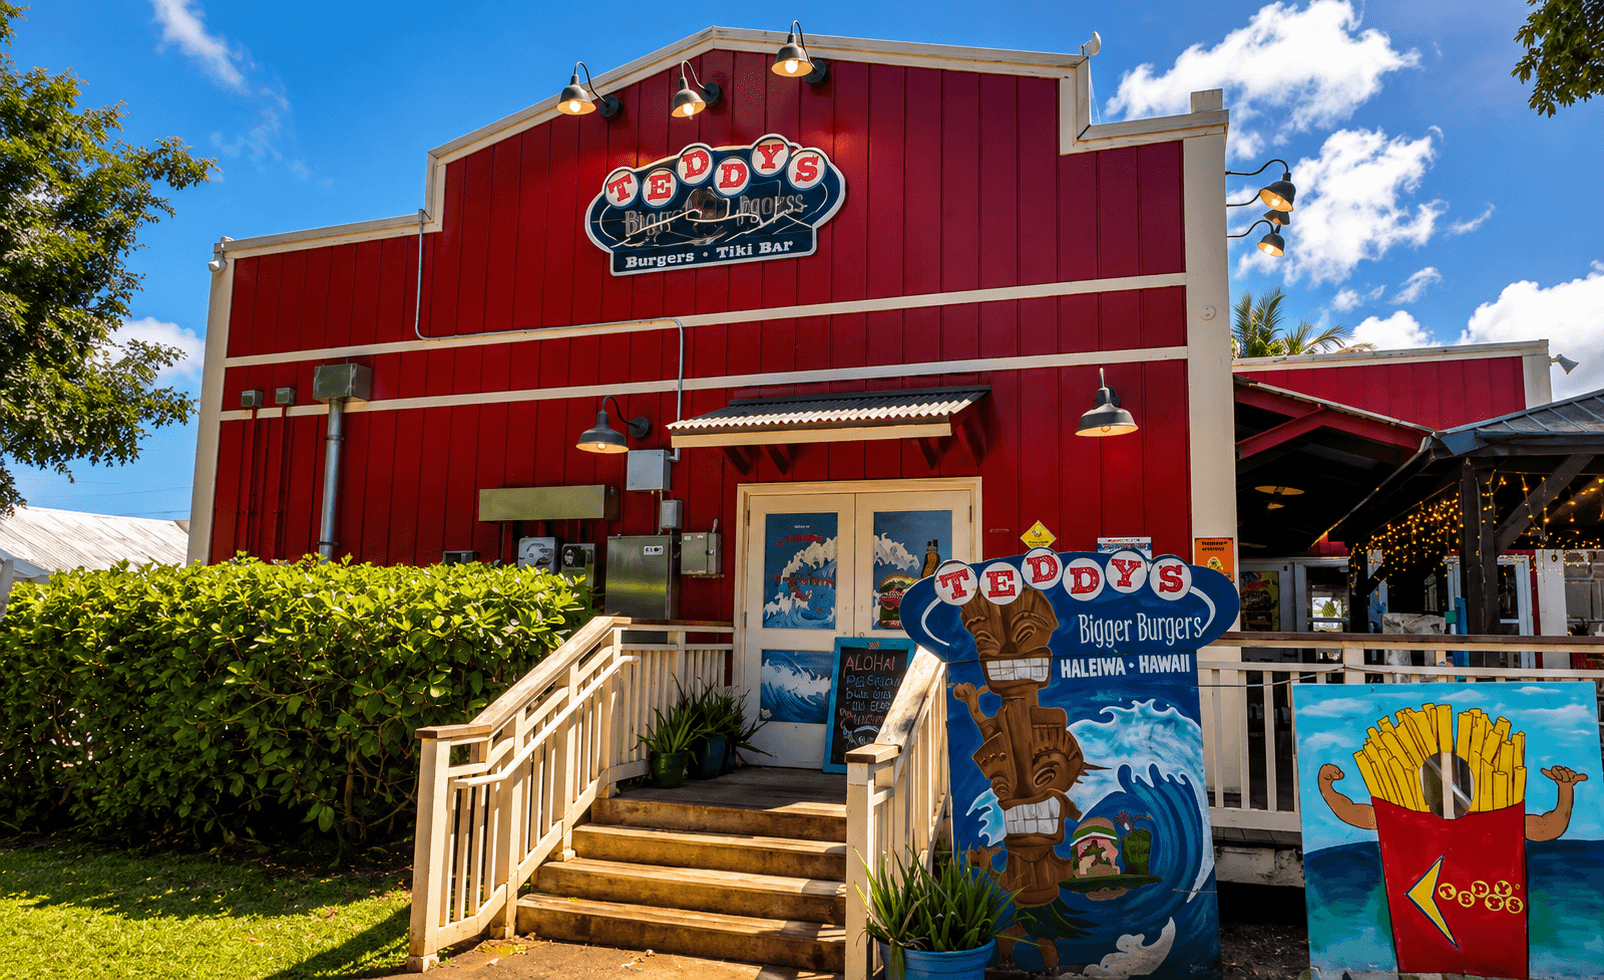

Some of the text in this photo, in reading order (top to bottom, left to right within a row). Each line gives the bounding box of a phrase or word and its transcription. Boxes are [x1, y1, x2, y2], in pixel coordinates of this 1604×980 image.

[607, 143, 820, 202] TEDDYS
[625, 251, 695, 269] Burgers
[716, 242, 753, 259] Tiki
[1078, 612, 1202, 649] Bigger Burgers
[1060, 654, 1191, 678] HALEIWA HAWAII
